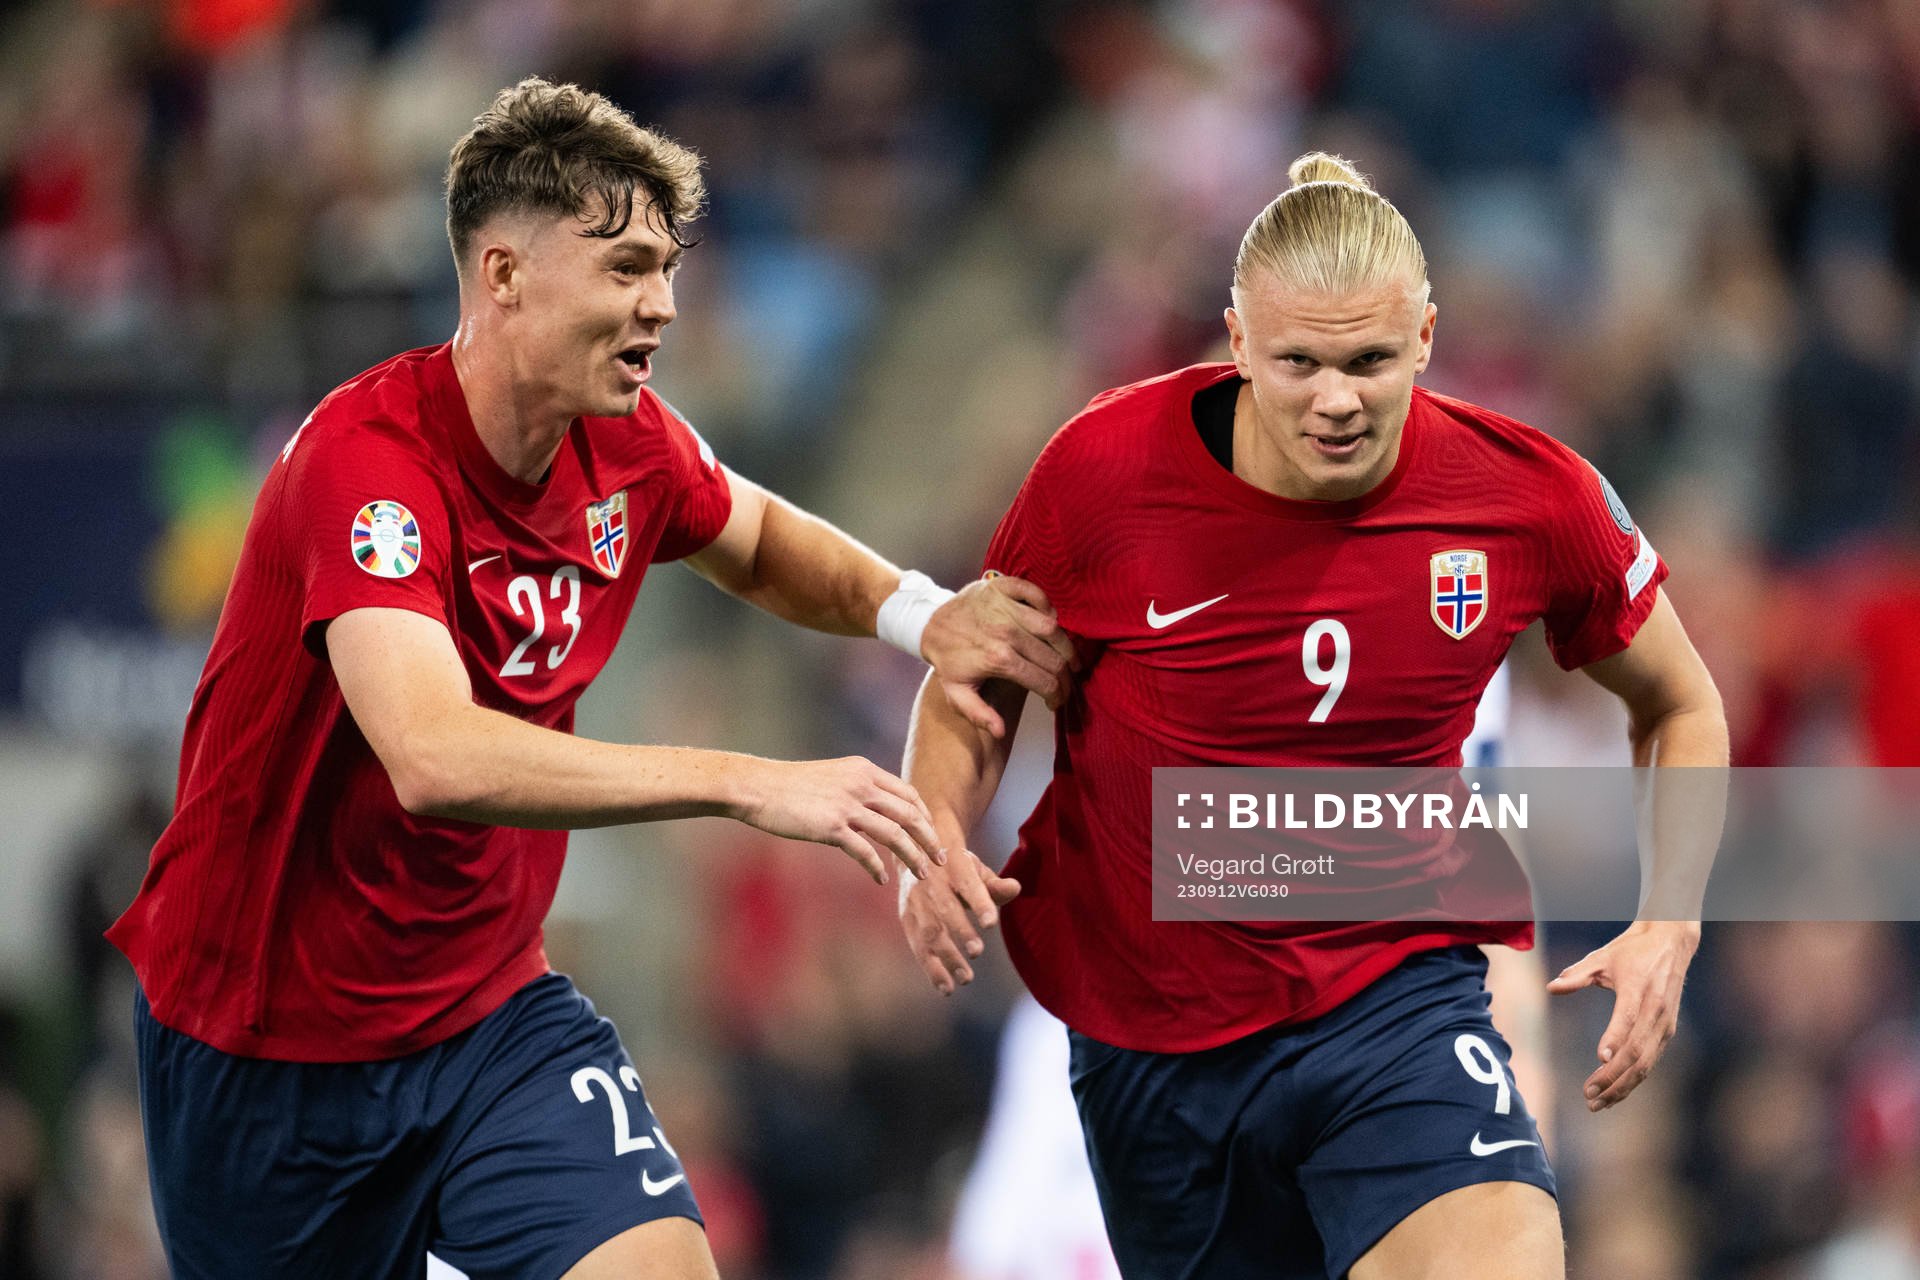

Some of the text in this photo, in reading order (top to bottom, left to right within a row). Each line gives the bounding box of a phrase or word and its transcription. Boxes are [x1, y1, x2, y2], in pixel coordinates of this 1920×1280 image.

[1449, 554, 1468, 562] NORGE
[499, 565, 582, 677] 23
[1302, 618, 1351, 723] 9
[1454, 1034, 1511, 1115] 9
